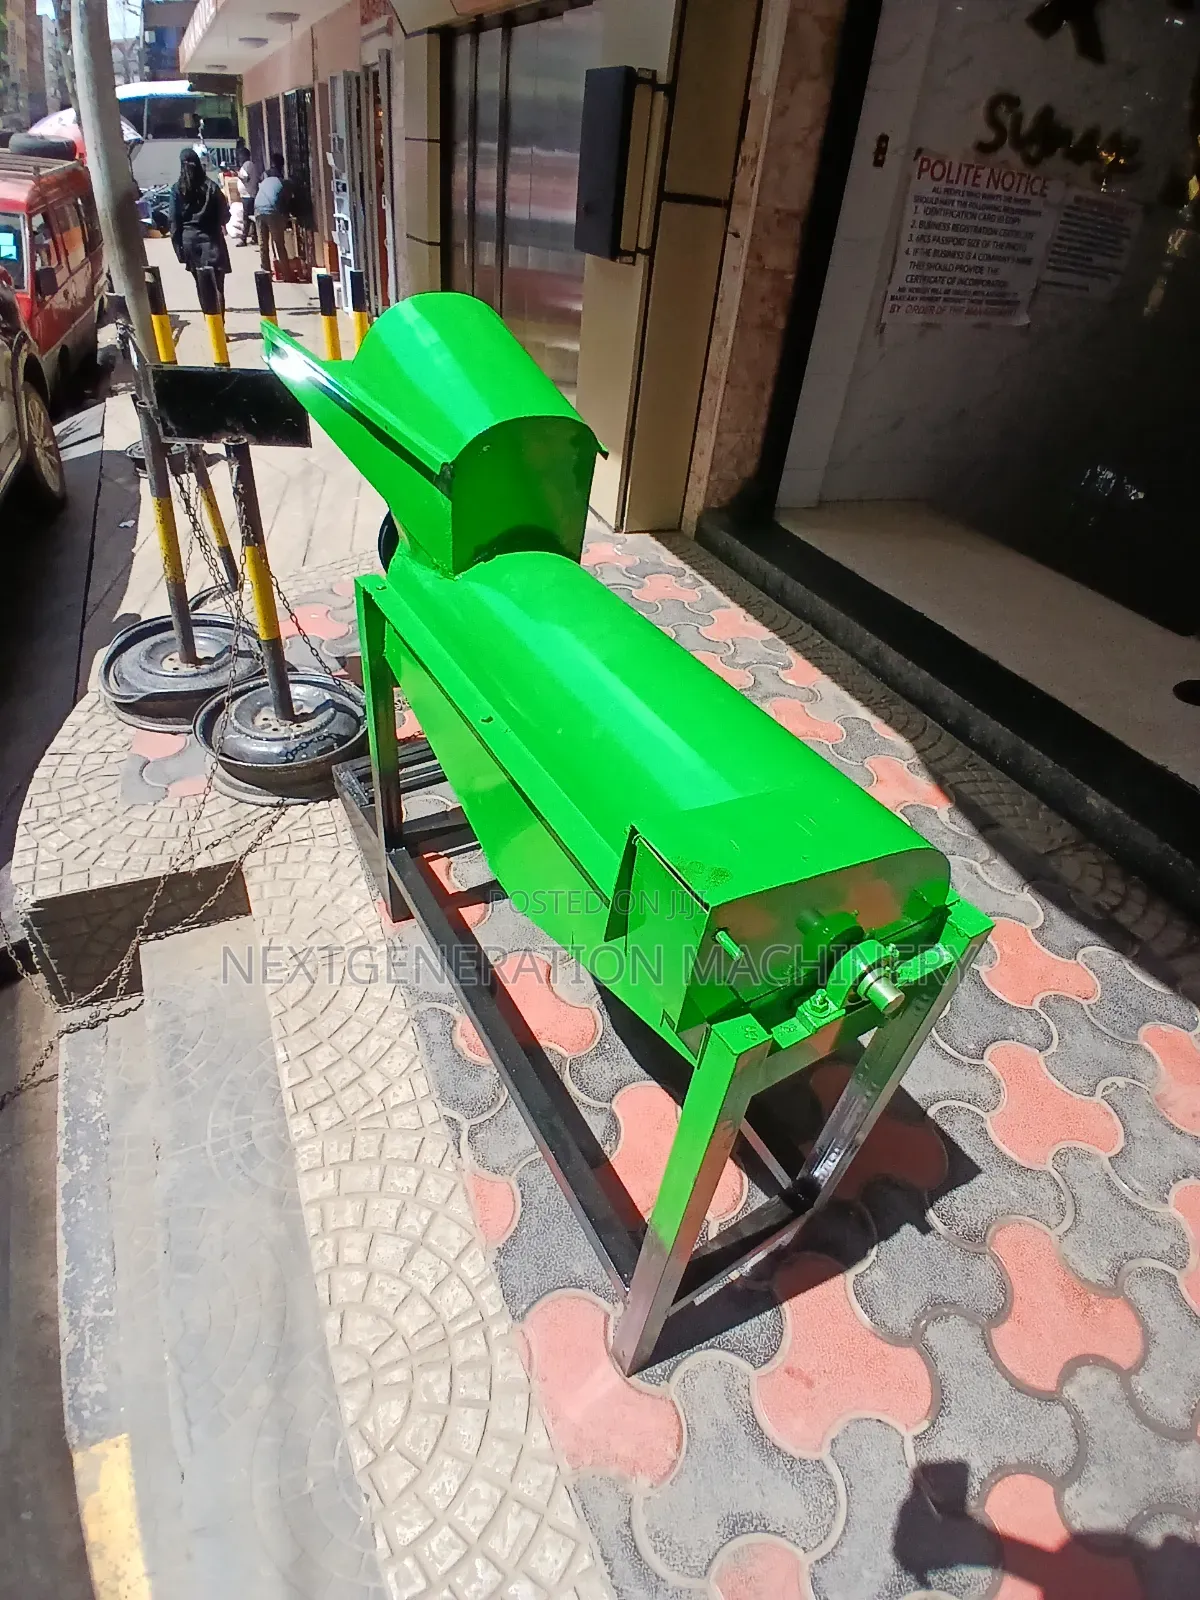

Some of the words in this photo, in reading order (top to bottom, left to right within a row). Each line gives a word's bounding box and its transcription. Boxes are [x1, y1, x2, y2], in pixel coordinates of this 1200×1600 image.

[917, 156, 985, 188] POLITE
[986, 167, 1047, 198] NOTICE
[923, 206, 977, 220] IDENTIFICATION
[978, 212, 996, 222] CARD
[918, 219, 951, 232] BUSINESS
[951, 223, 998, 236] REGISTRATION
[931, 235, 966, 246] PASSPORT
[981, 240, 991, 248] OF
[991, 240, 1005, 250] THE
[932, 248, 965, 260] BUSINESS
[926, 262, 954, 273] SHOULD
[954, 264, 984, 275] PROVIDE
[905, 274, 946, 285] CERTIFICATE
[889, 303, 901, 313] BY
[905, 304, 936, 315] ORDER
